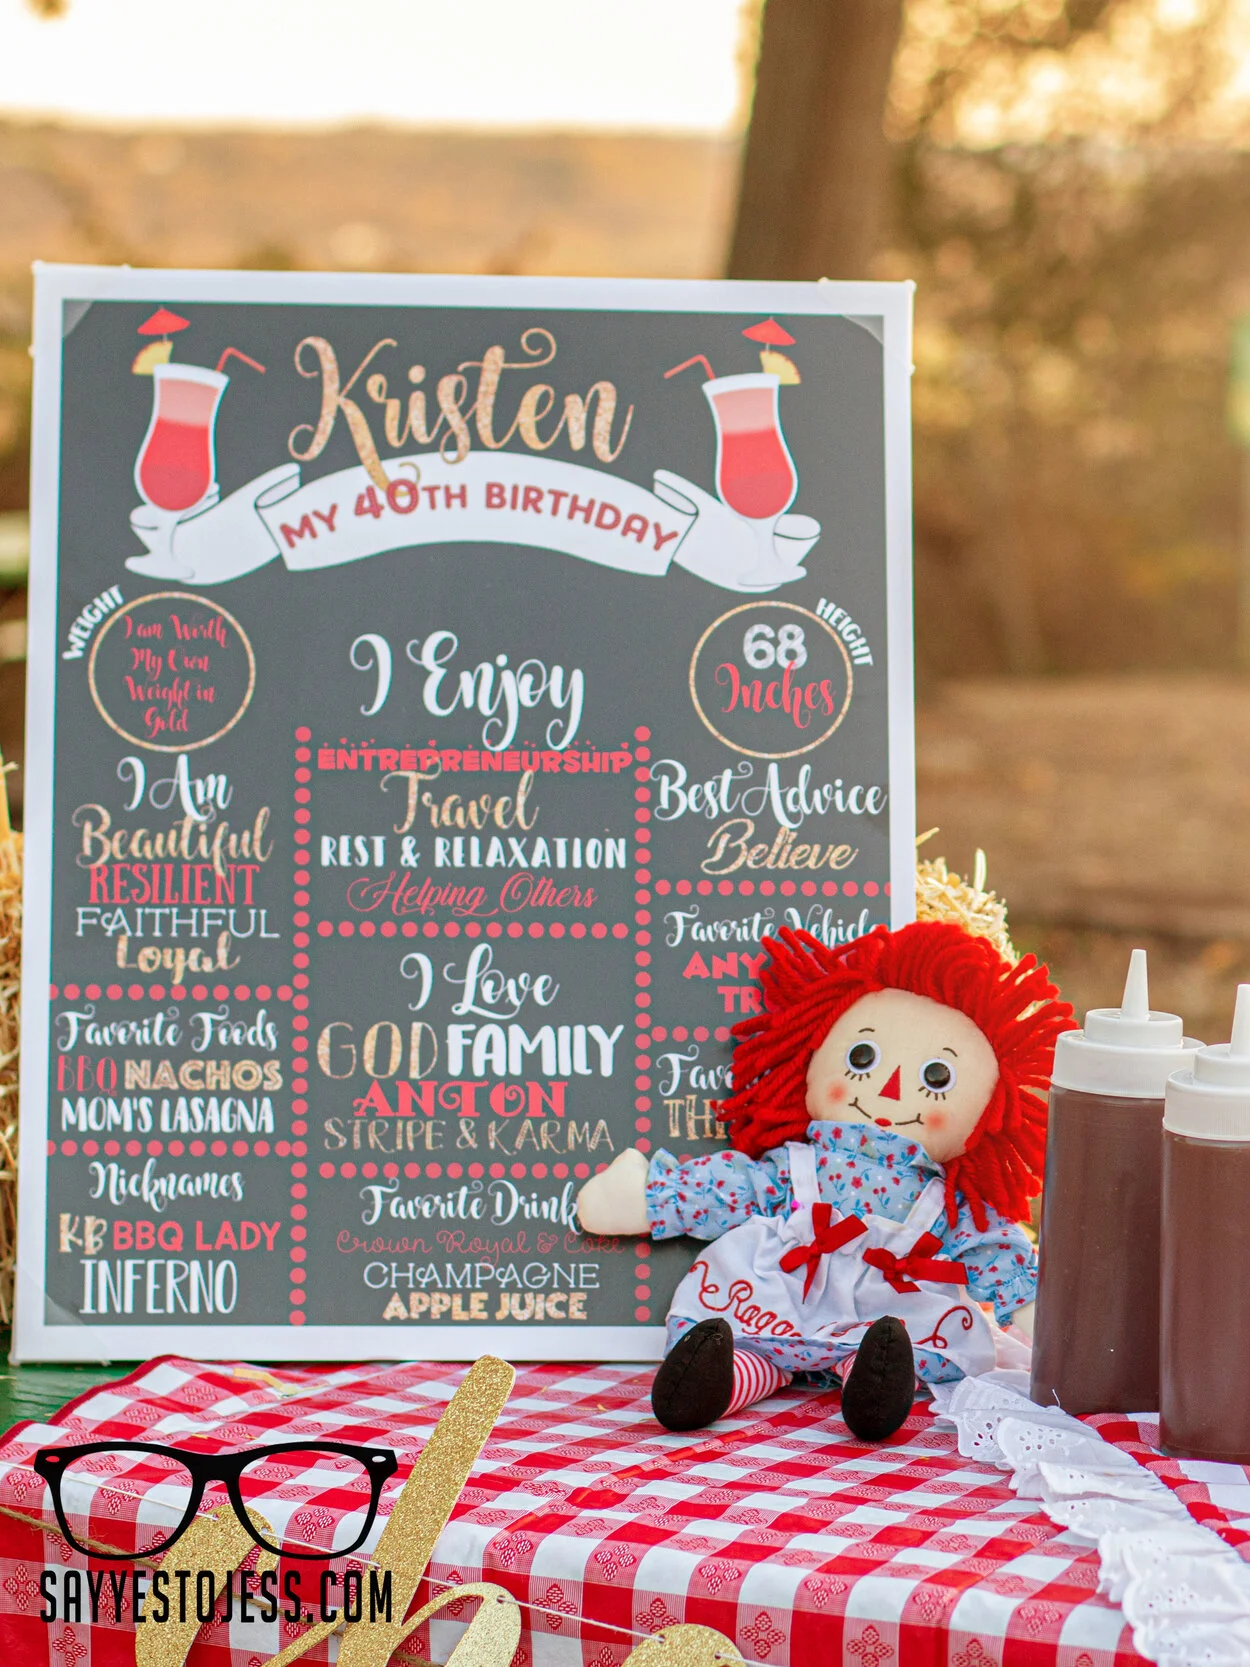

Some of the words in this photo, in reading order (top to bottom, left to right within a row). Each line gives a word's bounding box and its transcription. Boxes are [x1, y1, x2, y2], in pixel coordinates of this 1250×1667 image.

[288, 328, 634, 497] Kristen
[280, 503, 338, 549] MY
[354, 478, 468, 520] 40TH
[485, 482, 679, 552] BIRTHDAY
[62, 584, 124, 660] WEIGHT
[122, 615, 133, 640] I
[136, 623, 163, 640] am
[169, 613, 228, 648] Worth
[815, 598, 874, 666] HEIGHT
[131, 647, 163, 681] My
[167, 648, 210, 672] Own
[743, 623, 808, 669] 68
[124, 675, 191, 711] Weight
[196, 684, 216, 703] in
[350, 633, 393, 717] I
[405, 630, 585, 751] Enjoy
[714, 660, 836, 729] Inches
[144, 706, 190, 739] Gold
[317, 745, 633, 774] ENTREPRENEURSHIP
[117, 756, 145, 811] I
[150, 754, 233, 822] Am
[380, 757, 540, 834] Travel
[650, 759, 753, 821] Best
[741, 762, 888, 829] Advice
[72, 803, 275, 878] Beautiful
[320, 835, 386, 868] REST
[400, 835, 421, 868] &
[434, 836, 628, 869] RELAXATION
[701, 818, 859, 875] Believe
[88, 863, 260, 905] RESILIENT
[347, 871, 499, 917] Helping
[499, 872, 599, 913] Others
[75, 907, 281, 938] FAITHFUL
[663, 904, 776, 948] Favorite
[116, 931, 241, 985] Loyal
[400, 952, 434, 1011] I
[443, 943, 560, 1019] Love
[682, 951, 768, 979] ANY
[54, 1004, 184, 1052] Favorite
[189, 1004, 279, 1053] Foods
[317, 1021, 438, 1079] GOD
[446, 1023, 625, 1078] FAMILY
[57, 1055, 118, 1096] BBQ
[124, 1059, 283, 1091] NACHOS
[353, 1079, 569, 1118] ANTON
[61, 1096, 154, 1133] MOM'S
[160, 1096, 275, 1134] LASAGNA
[323, 1117, 446, 1153] STRIPE
[456, 1119, 479, 1151] &
[487, 1119, 615, 1156] KARMA
[88, 1157, 245, 1213] Nicknames
[359, 1177, 488, 1226] Favorite
[487, 1179, 583, 1236] Drink
[58, 1213, 108, 1255] KB
[113, 1220, 185, 1252] BBQ
[195, 1220, 282, 1251] LADY
[336, 1230, 432, 1254] Crown
[436, 1230, 532, 1269] Royal
[537, 1231, 558, 1254] &
[79, 1259, 238, 1315] INFERNO
[363, 1262, 601, 1288] CHAMPAGNE
[382, 1292, 489, 1321] APPLE
[495, 1292, 588, 1321] JUICE
